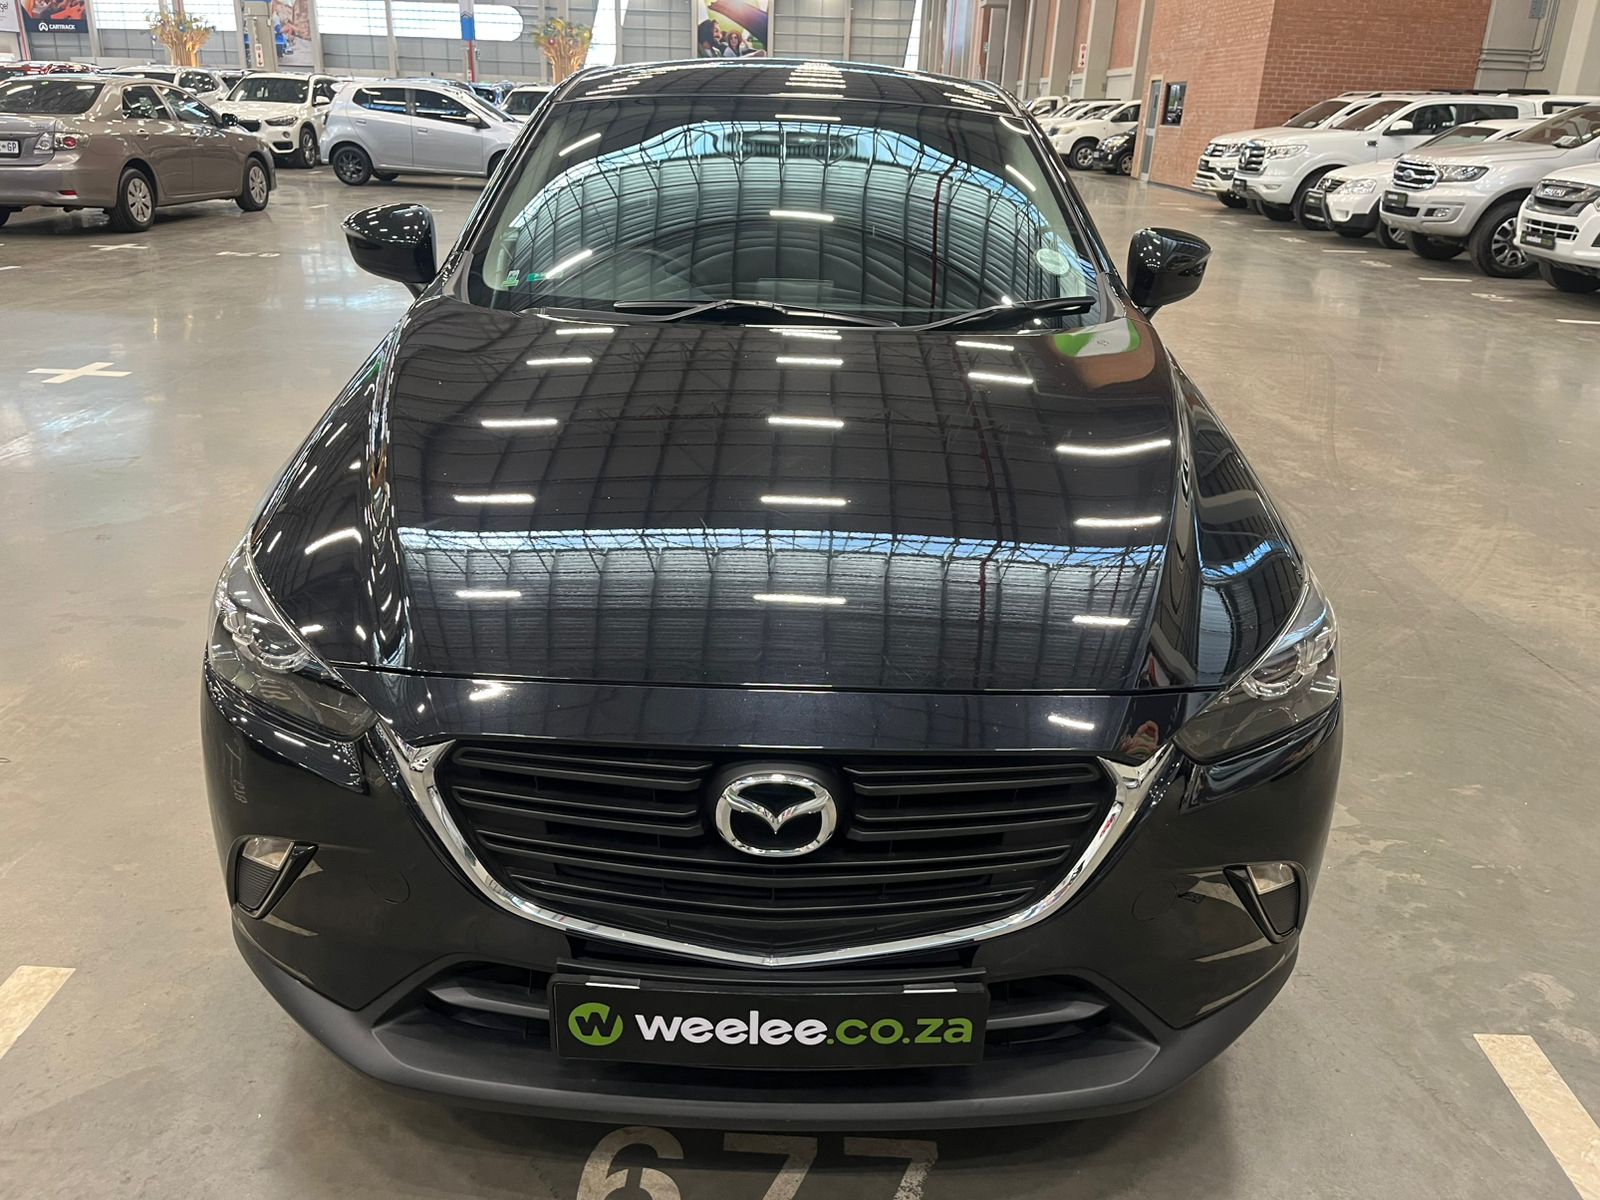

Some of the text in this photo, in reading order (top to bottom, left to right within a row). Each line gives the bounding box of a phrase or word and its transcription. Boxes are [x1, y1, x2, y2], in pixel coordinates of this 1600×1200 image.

[7, 142, 17, 152] GP
[633, 1009, 974, 1046] weelee.co.za
[575, 1125, 939, 1200] 677
